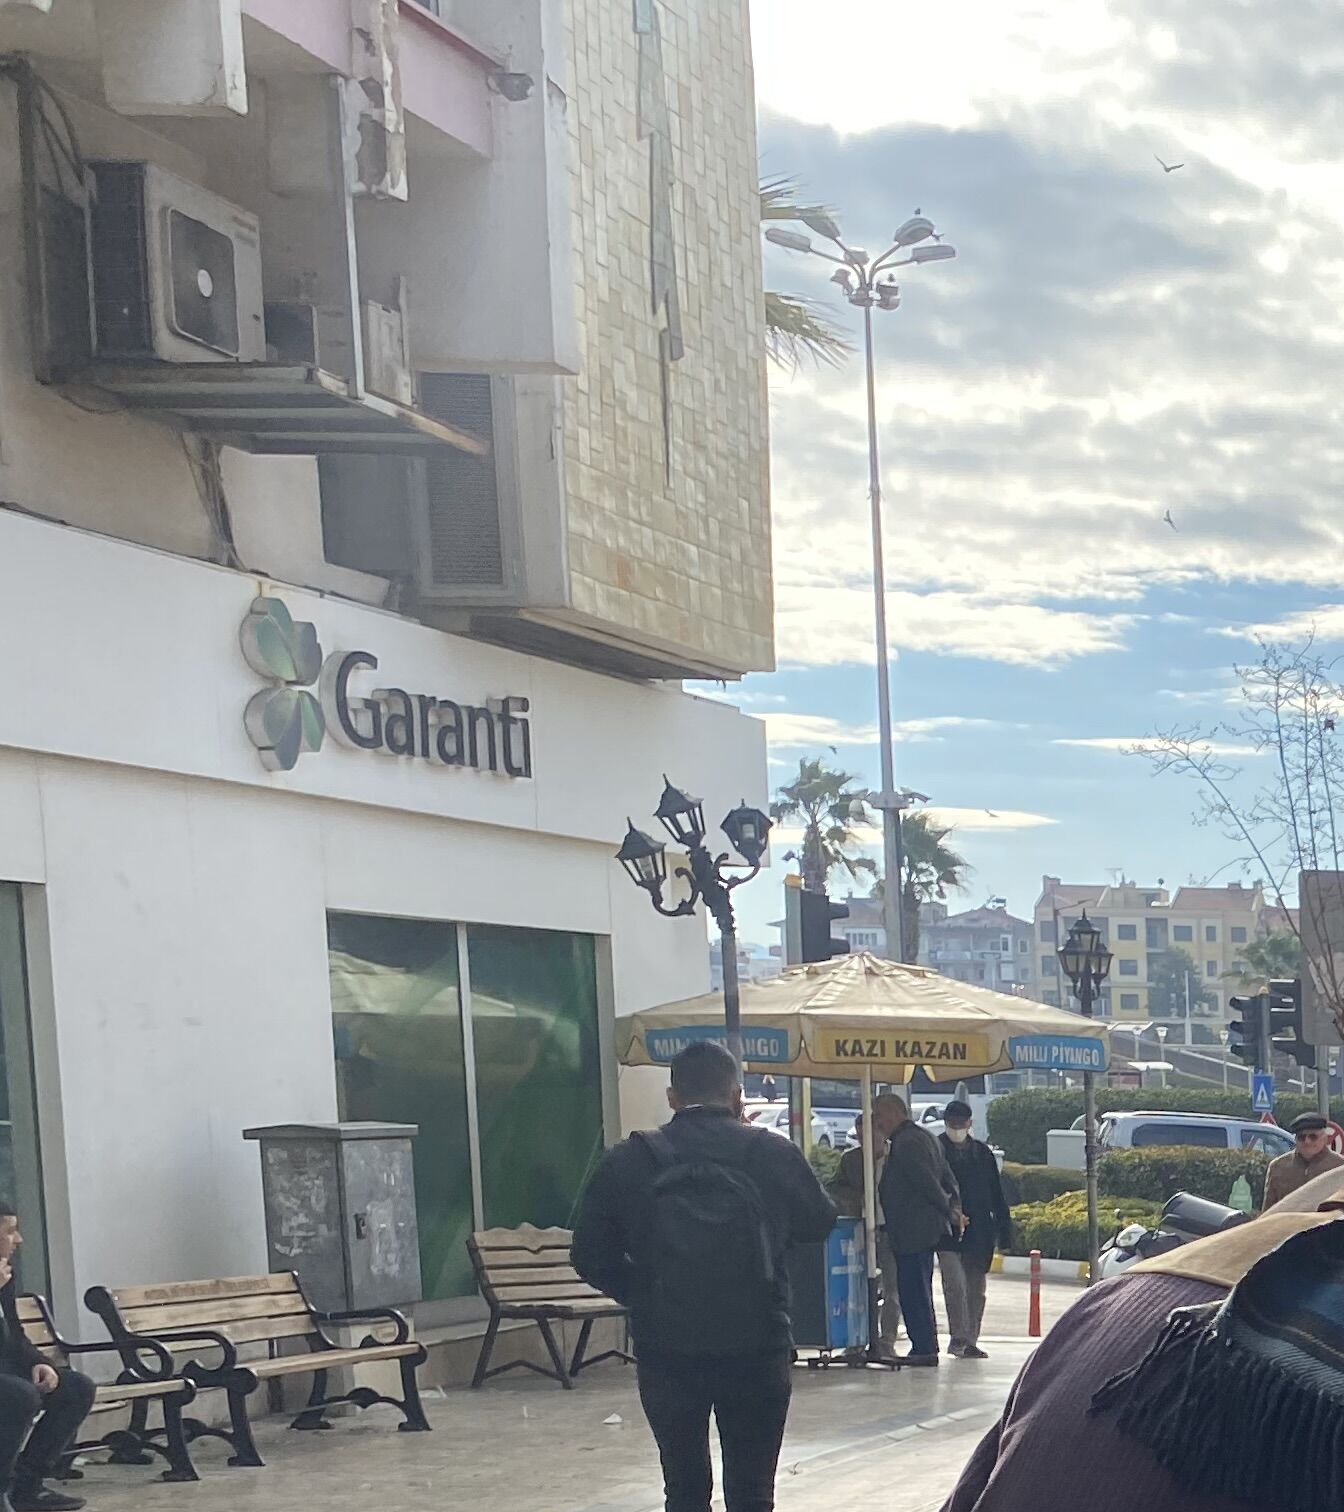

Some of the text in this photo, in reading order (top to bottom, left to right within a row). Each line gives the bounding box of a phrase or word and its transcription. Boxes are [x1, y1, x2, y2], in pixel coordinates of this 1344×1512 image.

[333, 650, 532, 779] Garanti
[834, 1038, 968, 1061] KAZI KAZAN
